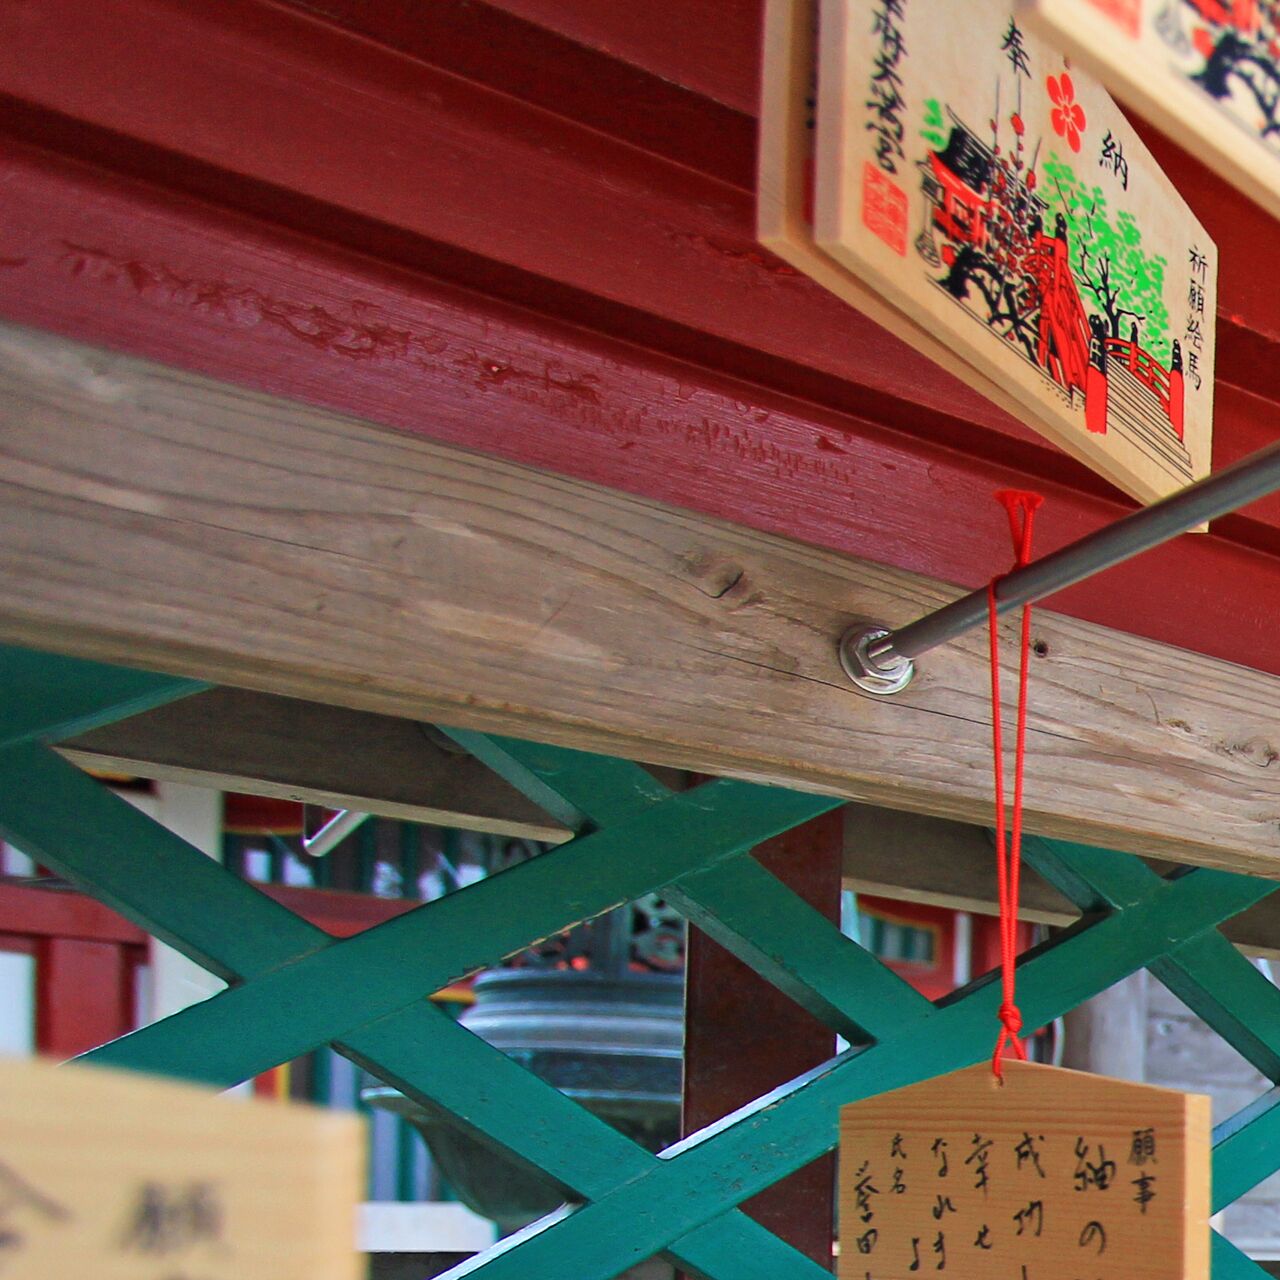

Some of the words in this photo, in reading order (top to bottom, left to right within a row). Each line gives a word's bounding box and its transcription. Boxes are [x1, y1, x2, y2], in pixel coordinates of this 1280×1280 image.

[1002, 17, 1031, 79] 奉
[1099, 129, 1129, 191] 納
[1184, 244, 1208, 391] 祈願絵馬
[890, 1132, 908, 1195] 氏名
[1127, 1128, 1160, 1215] 願事
